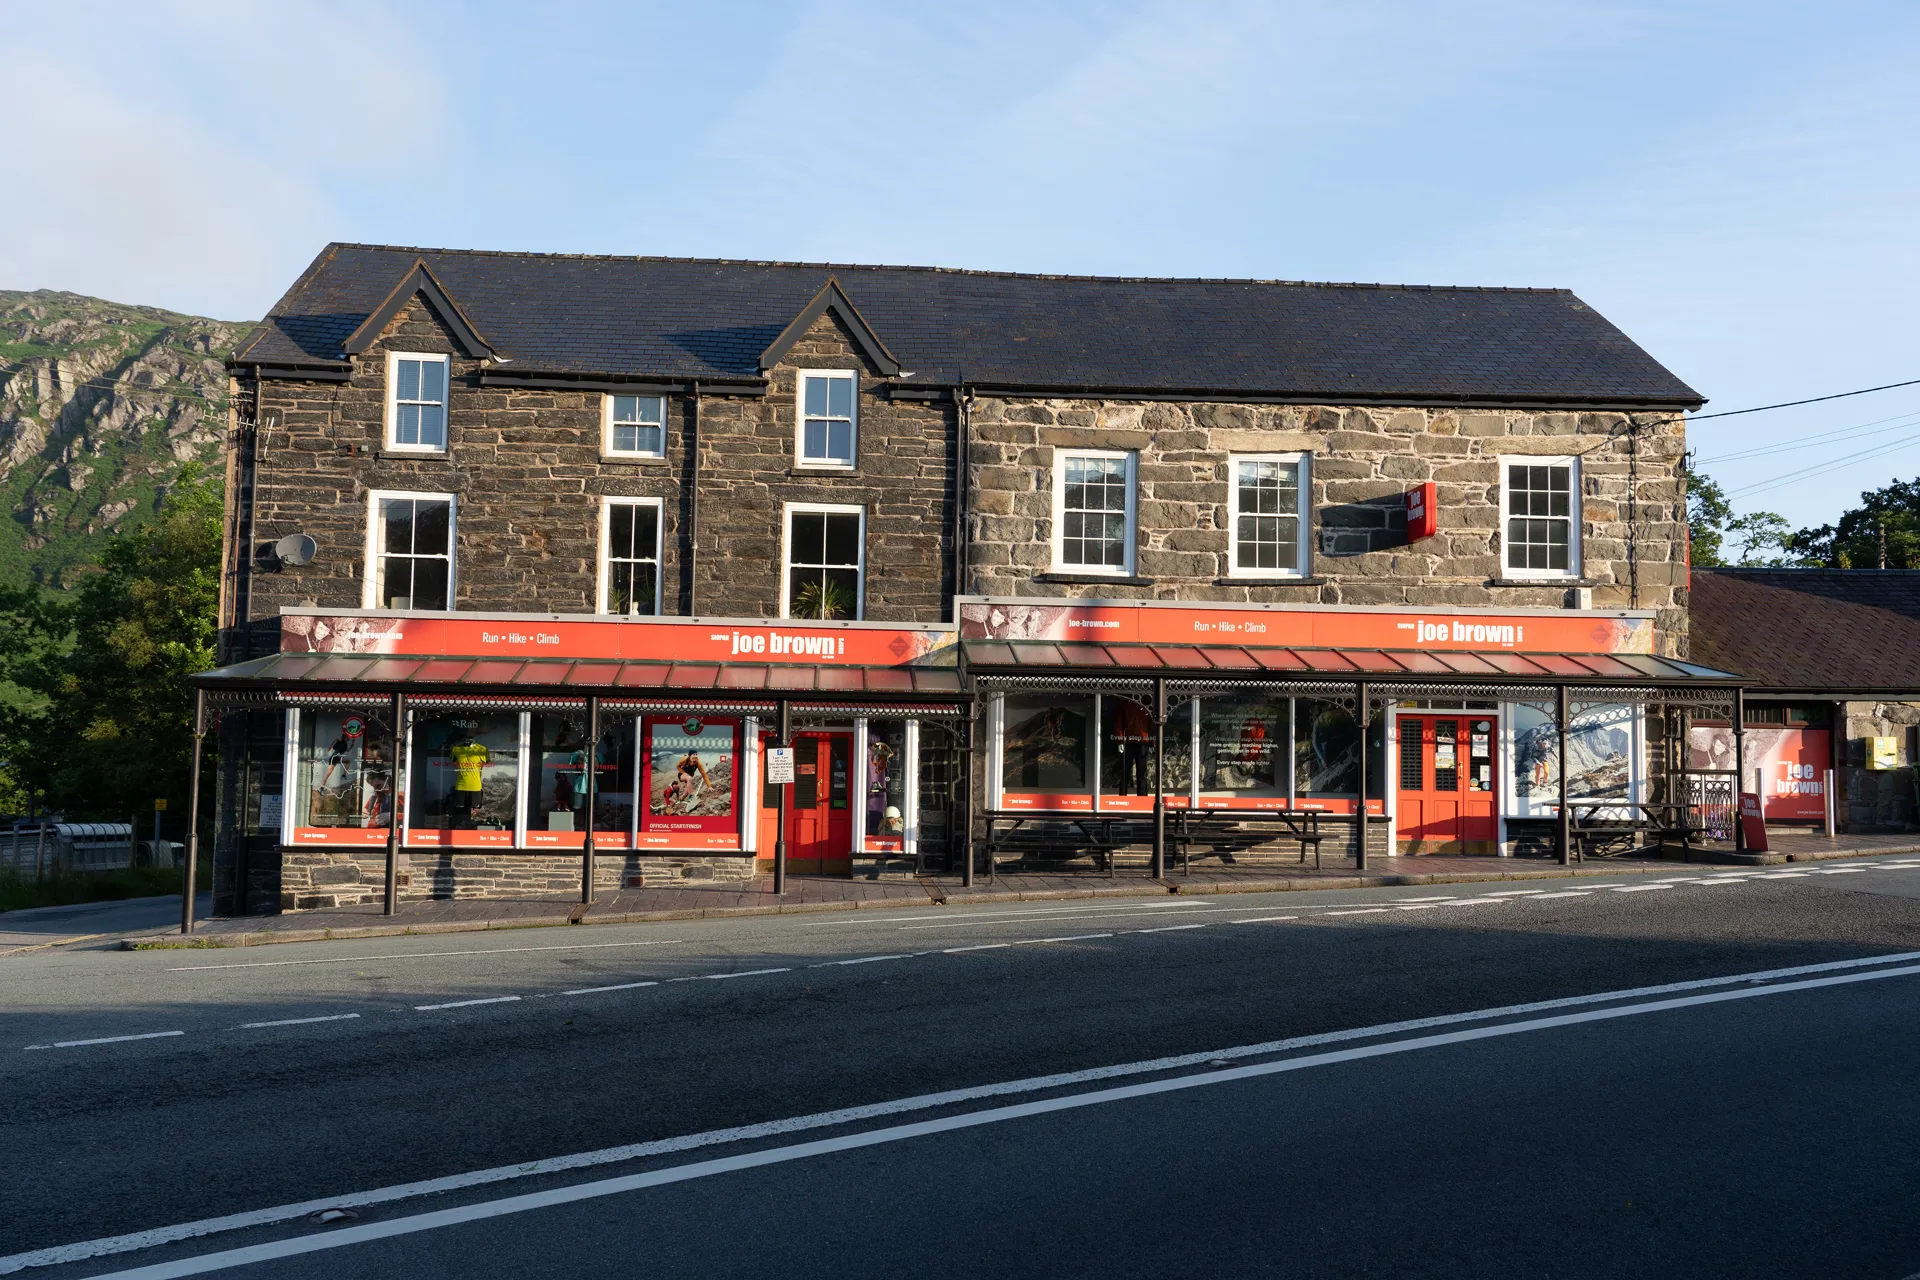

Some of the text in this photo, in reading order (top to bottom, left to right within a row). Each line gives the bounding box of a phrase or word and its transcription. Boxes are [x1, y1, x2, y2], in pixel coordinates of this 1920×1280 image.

[1068, 619, 1120, 629] joe-brown.com
[1194, 621, 1266, 633] Run Hike Climb
[482, 632, 560, 645] Run Hike Climb
[1417, 620, 1514, 643] joe brown
[731, 631, 835, 655] joe brown
[460, 719, 479, 729] Rab
[1786, 760, 1814, 781] joe
[1776, 779, 1819, 794] brown
